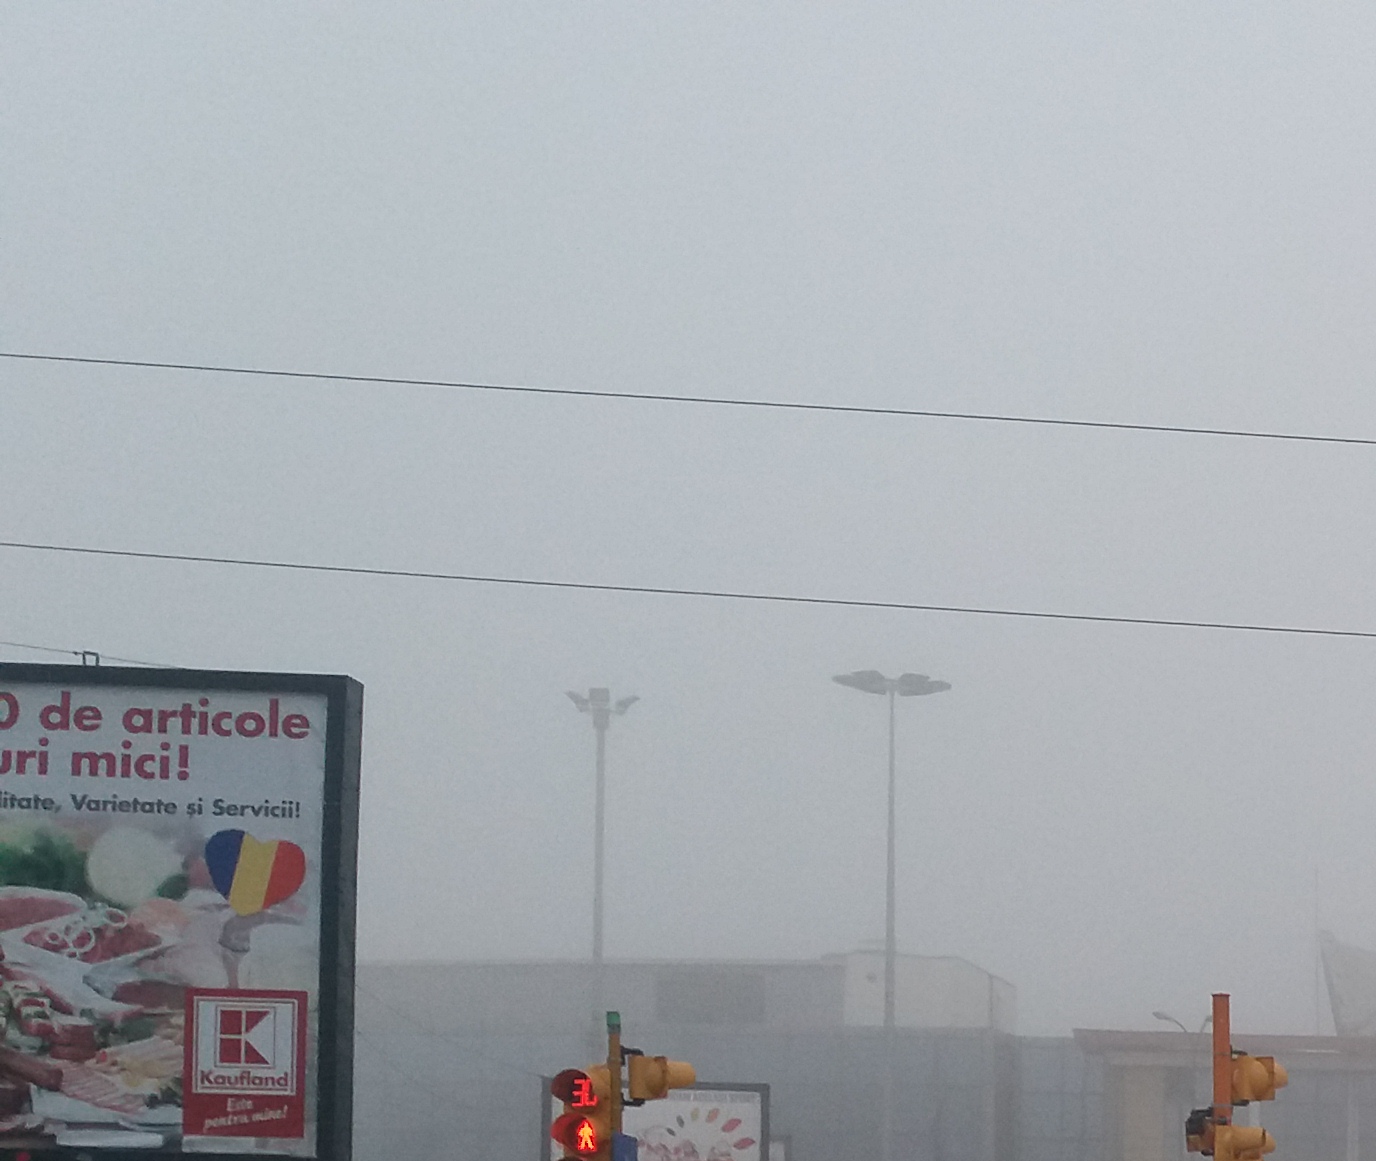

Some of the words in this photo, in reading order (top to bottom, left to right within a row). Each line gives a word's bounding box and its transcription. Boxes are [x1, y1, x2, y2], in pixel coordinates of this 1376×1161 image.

[39, 690, 103, 732] de
[122, 697, 310, 740] articole
[71, 740, 190, 781] mici!
[70, 793, 178, 817] Varietate
[212, 798, 301, 819] Servicii!
[200, 1069, 289, 1087] Kaufland
